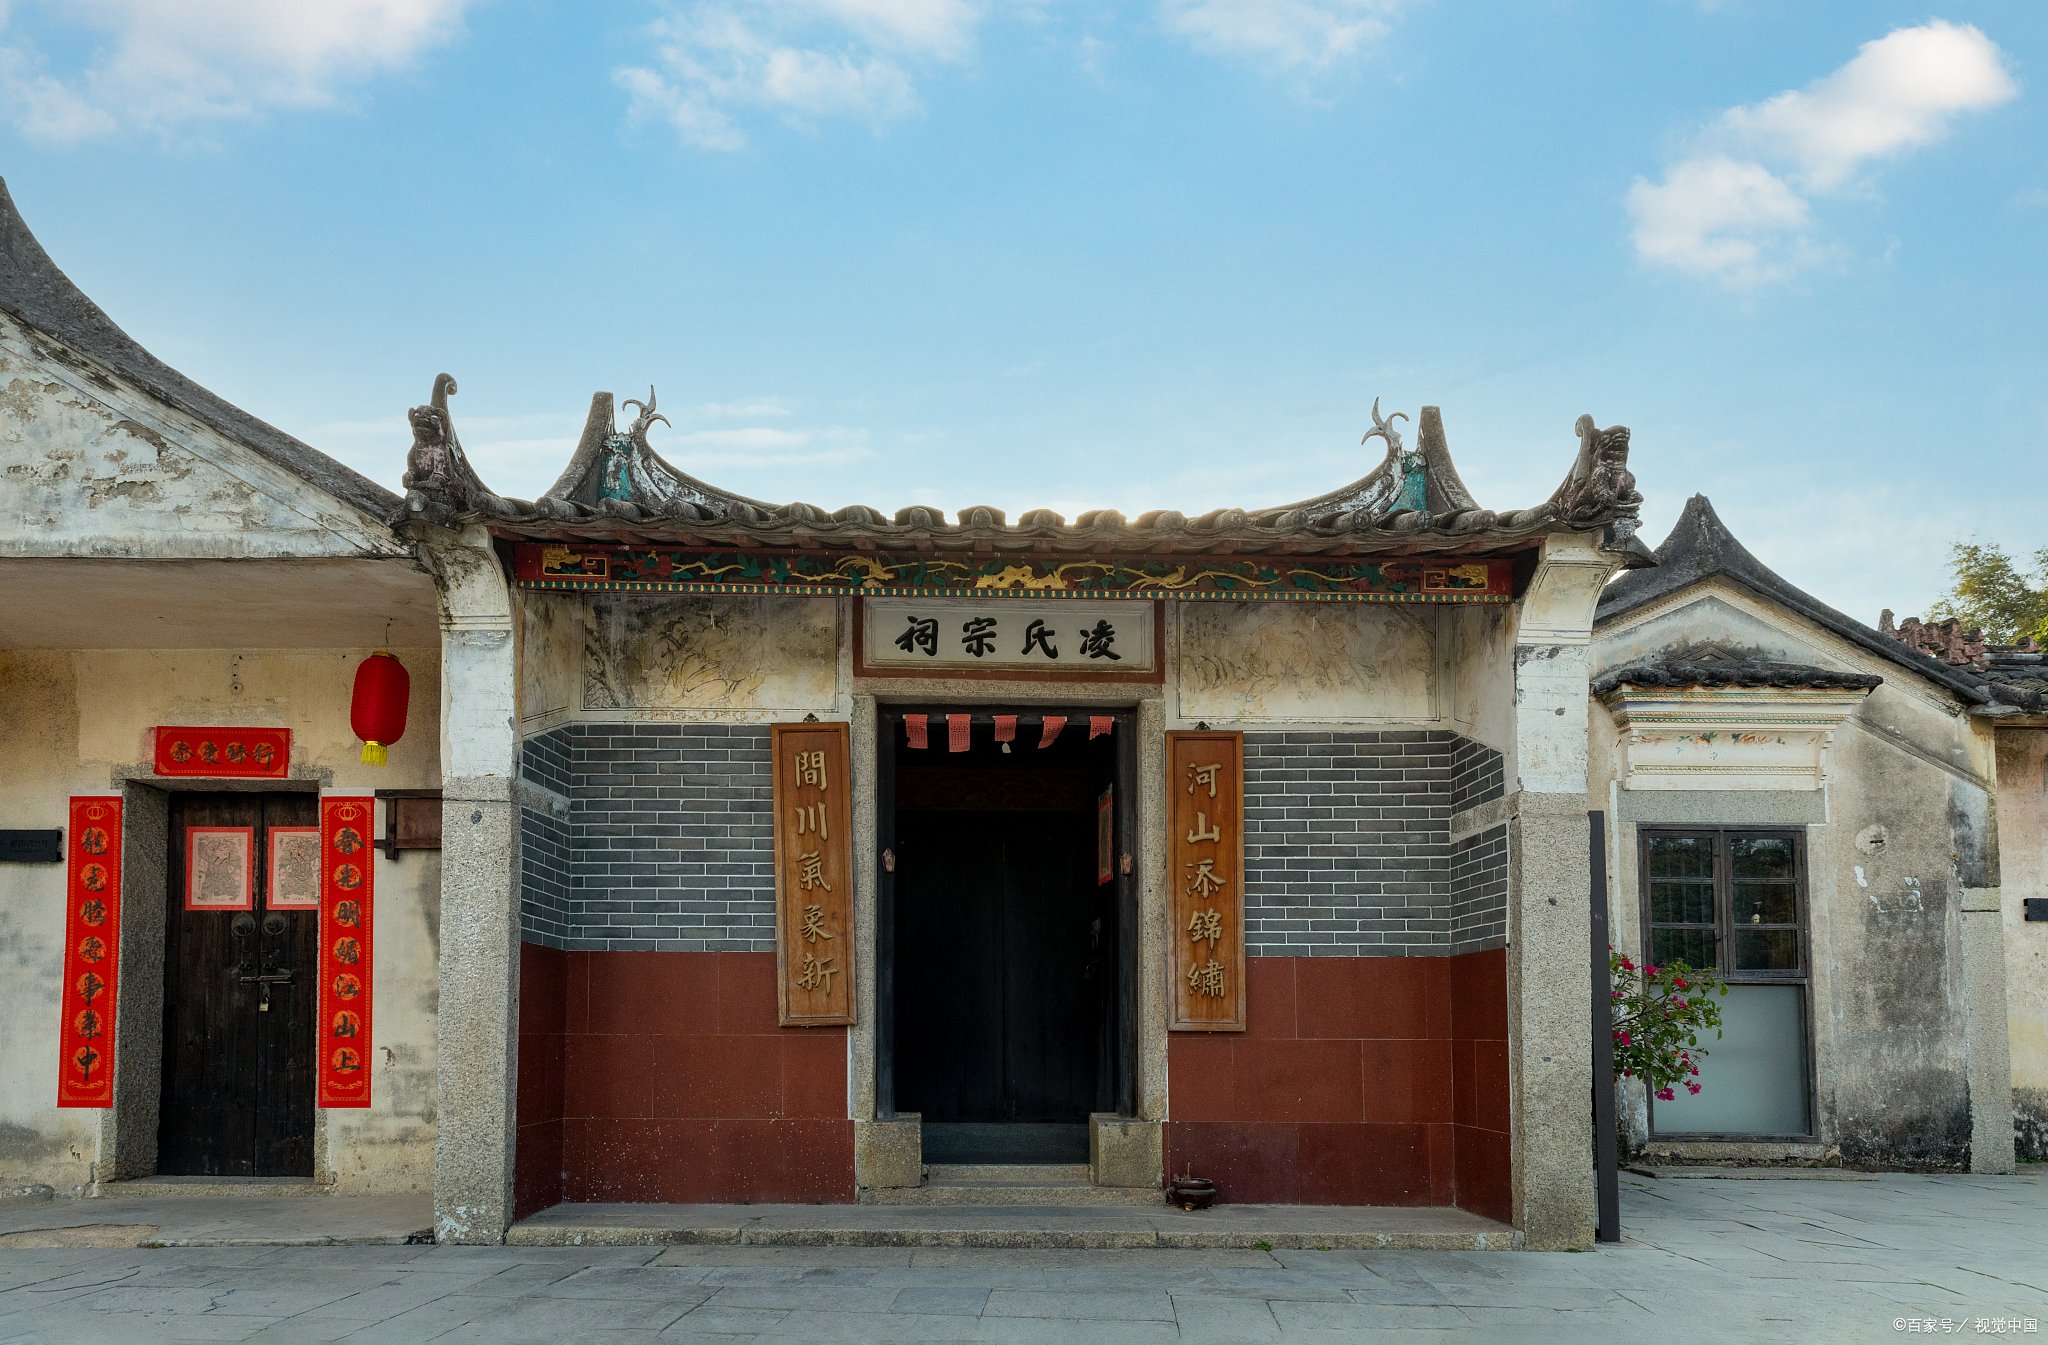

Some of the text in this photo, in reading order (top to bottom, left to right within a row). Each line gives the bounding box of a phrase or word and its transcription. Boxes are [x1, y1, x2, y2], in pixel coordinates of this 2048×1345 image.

[894, 615, 1122, 661] 凌氏宗祠
[1185, 762, 1227, 1000] 河山添錦繡
